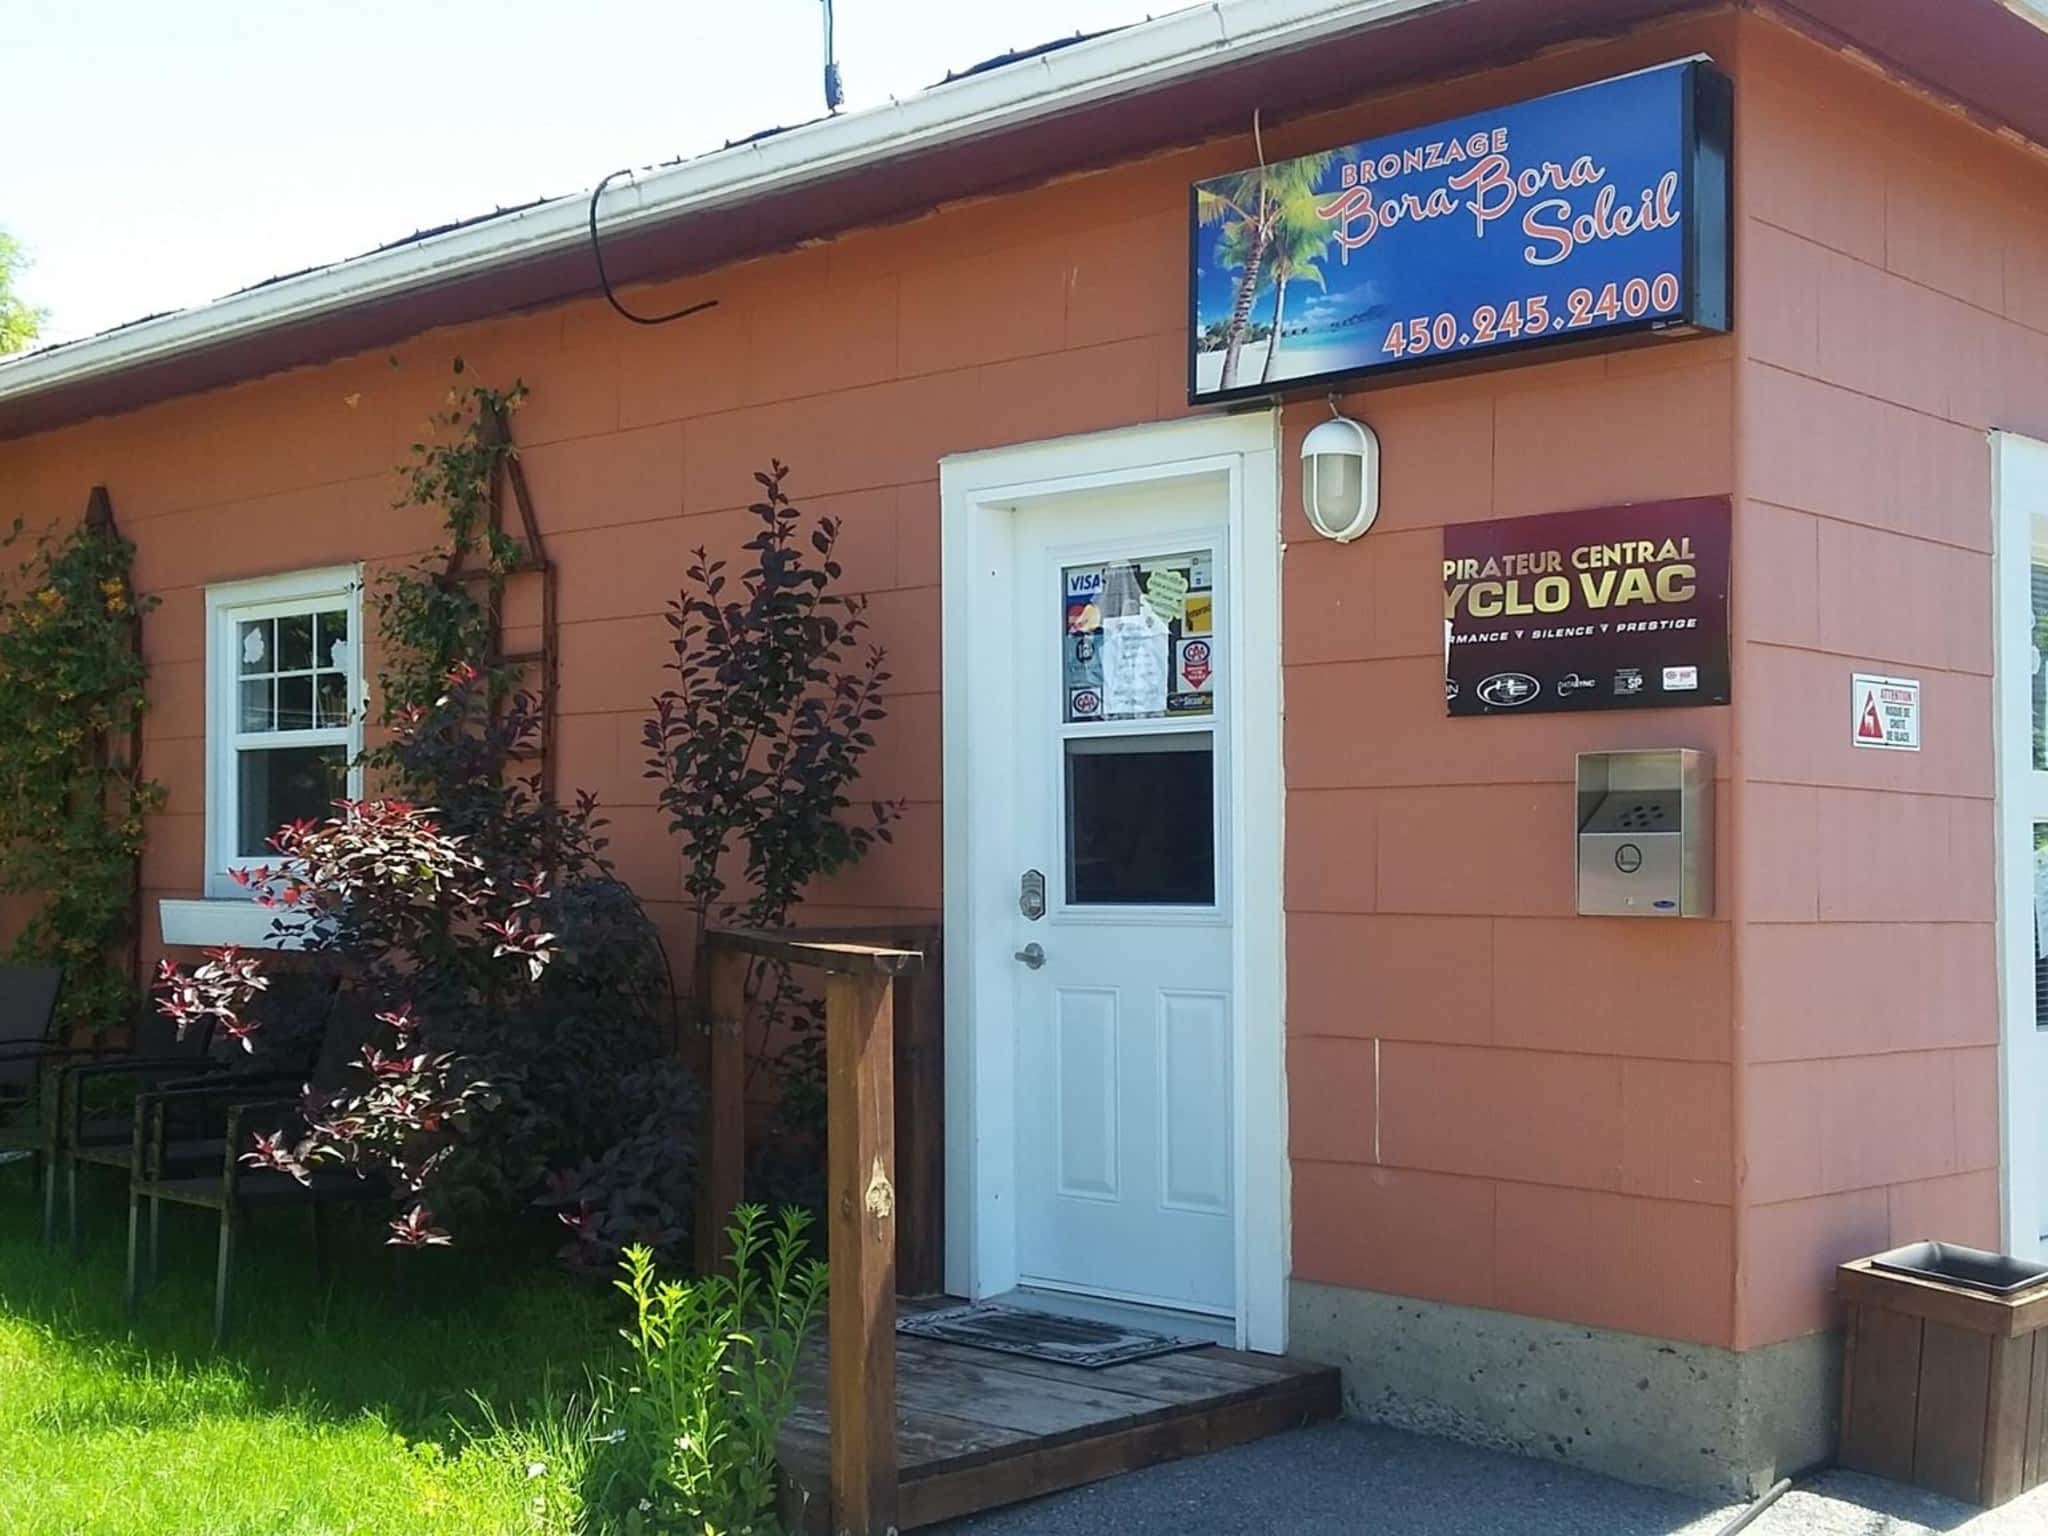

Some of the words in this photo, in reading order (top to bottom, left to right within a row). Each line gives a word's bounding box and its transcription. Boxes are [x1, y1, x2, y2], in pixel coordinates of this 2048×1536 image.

[1341, 127, 1509, 190] BRONZAGE
[1317, 185, 1459, 265] Bora
[1448, 154, 1607, 238] Bora
[1522, 171, 1681, 266] Soleil
[1382, 272, 1680, 357] 450.245.2400
[1070, 573, 1100, 592] VISA
[1442, 550, 1562, 581] PIRATEUR
[1571, 537, 1696, 570] CENTRAL
[1579, 563, 1697, 608] VAC
[1531, 625, 1595, 640] SILENCE
[1616, 618, 1698, 633] PRESTIGE
